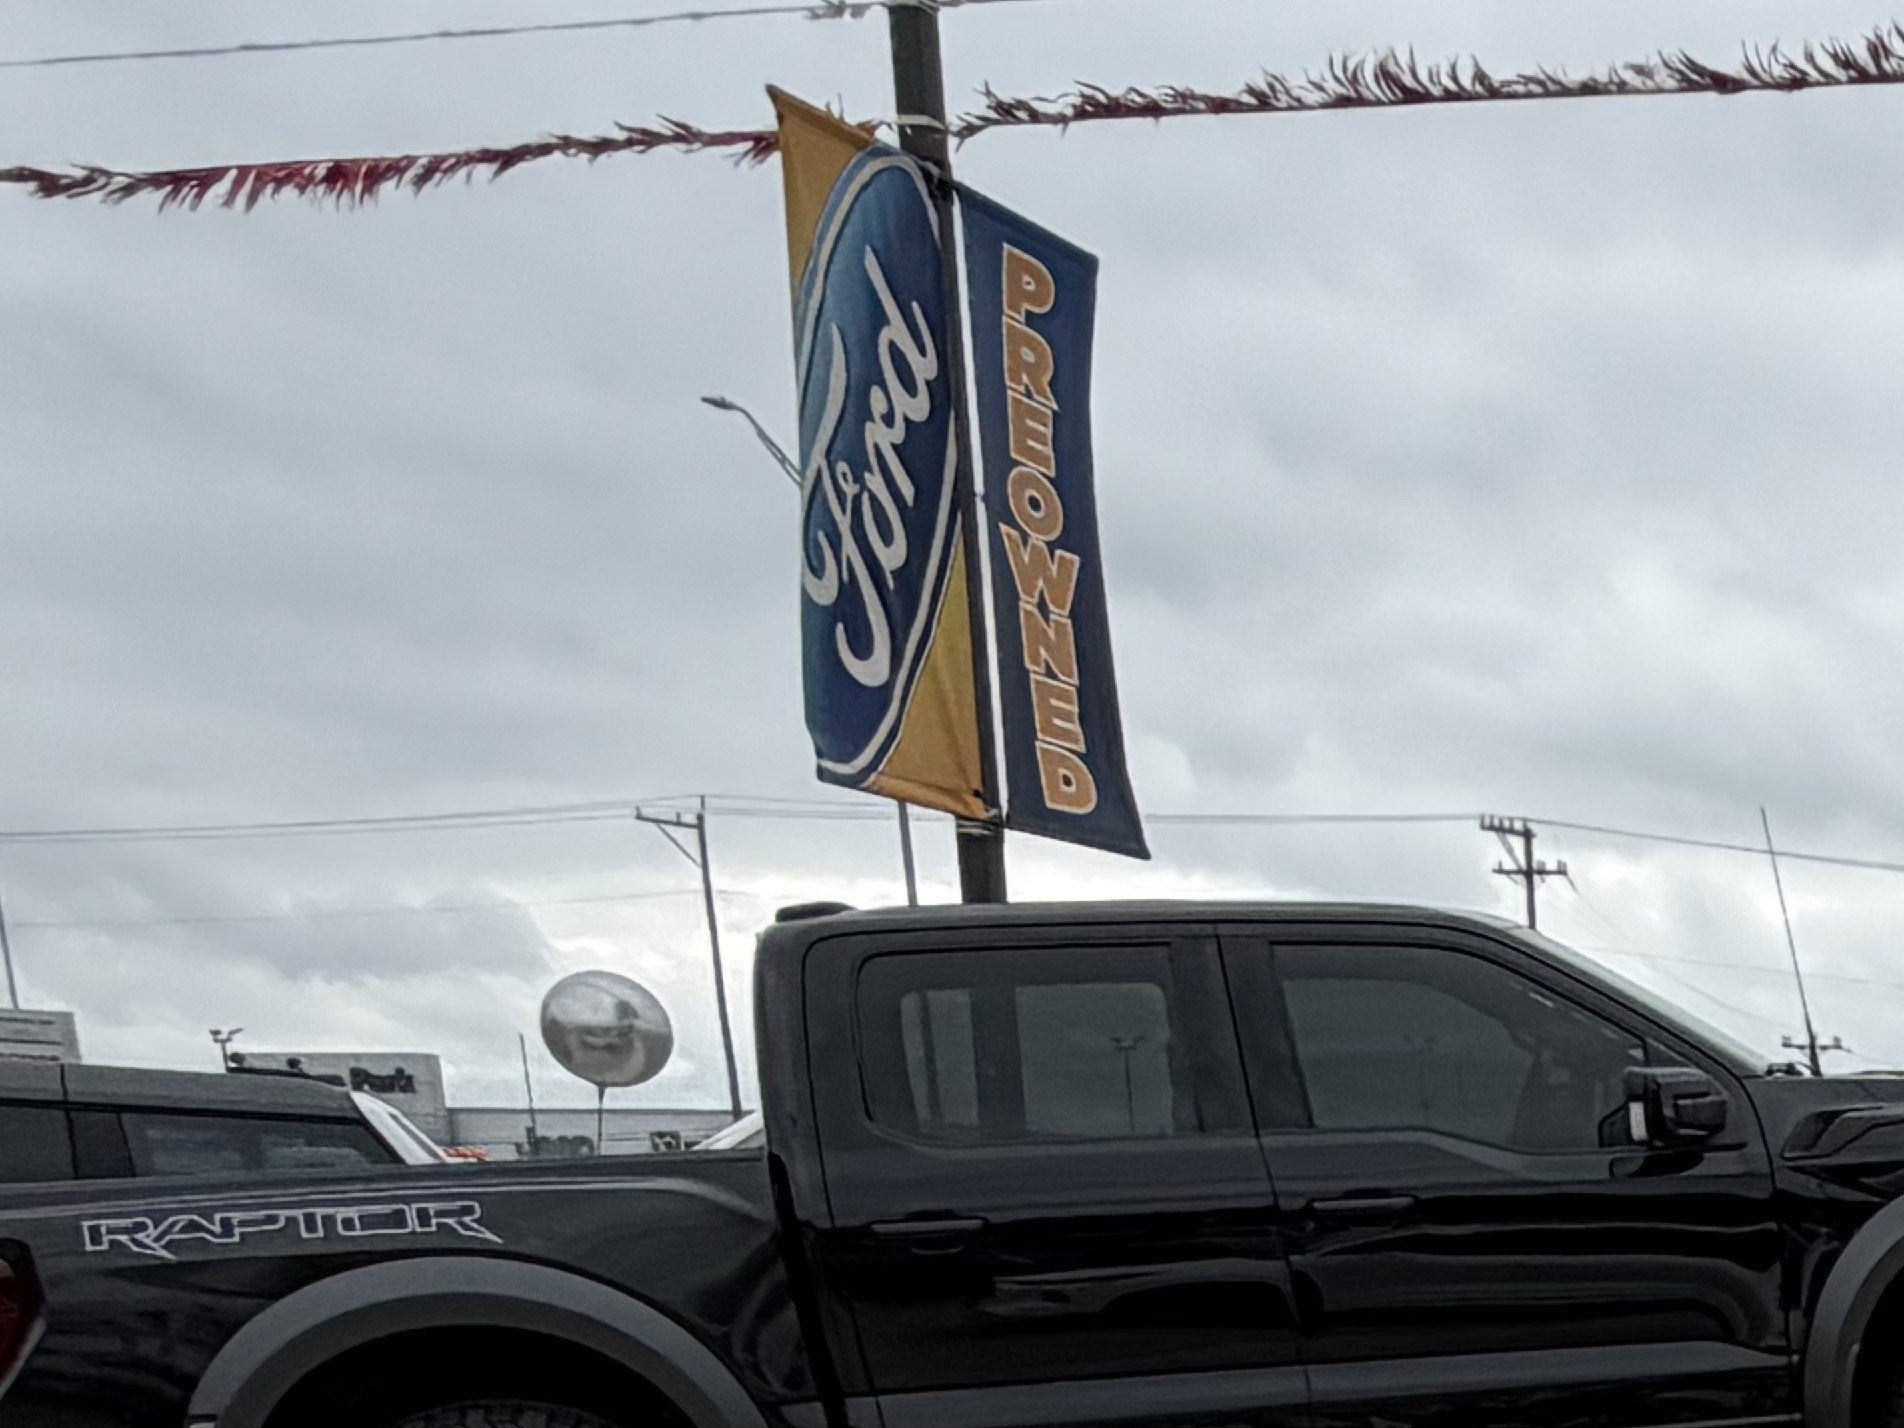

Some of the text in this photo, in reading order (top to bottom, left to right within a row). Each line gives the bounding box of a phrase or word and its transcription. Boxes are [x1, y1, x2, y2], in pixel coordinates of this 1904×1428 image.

[802, 244, 939, 688] Ford
[1000, 243, 1097, 816] PREOWNED
[81, 1201, 503, 1261] RAPTOR
